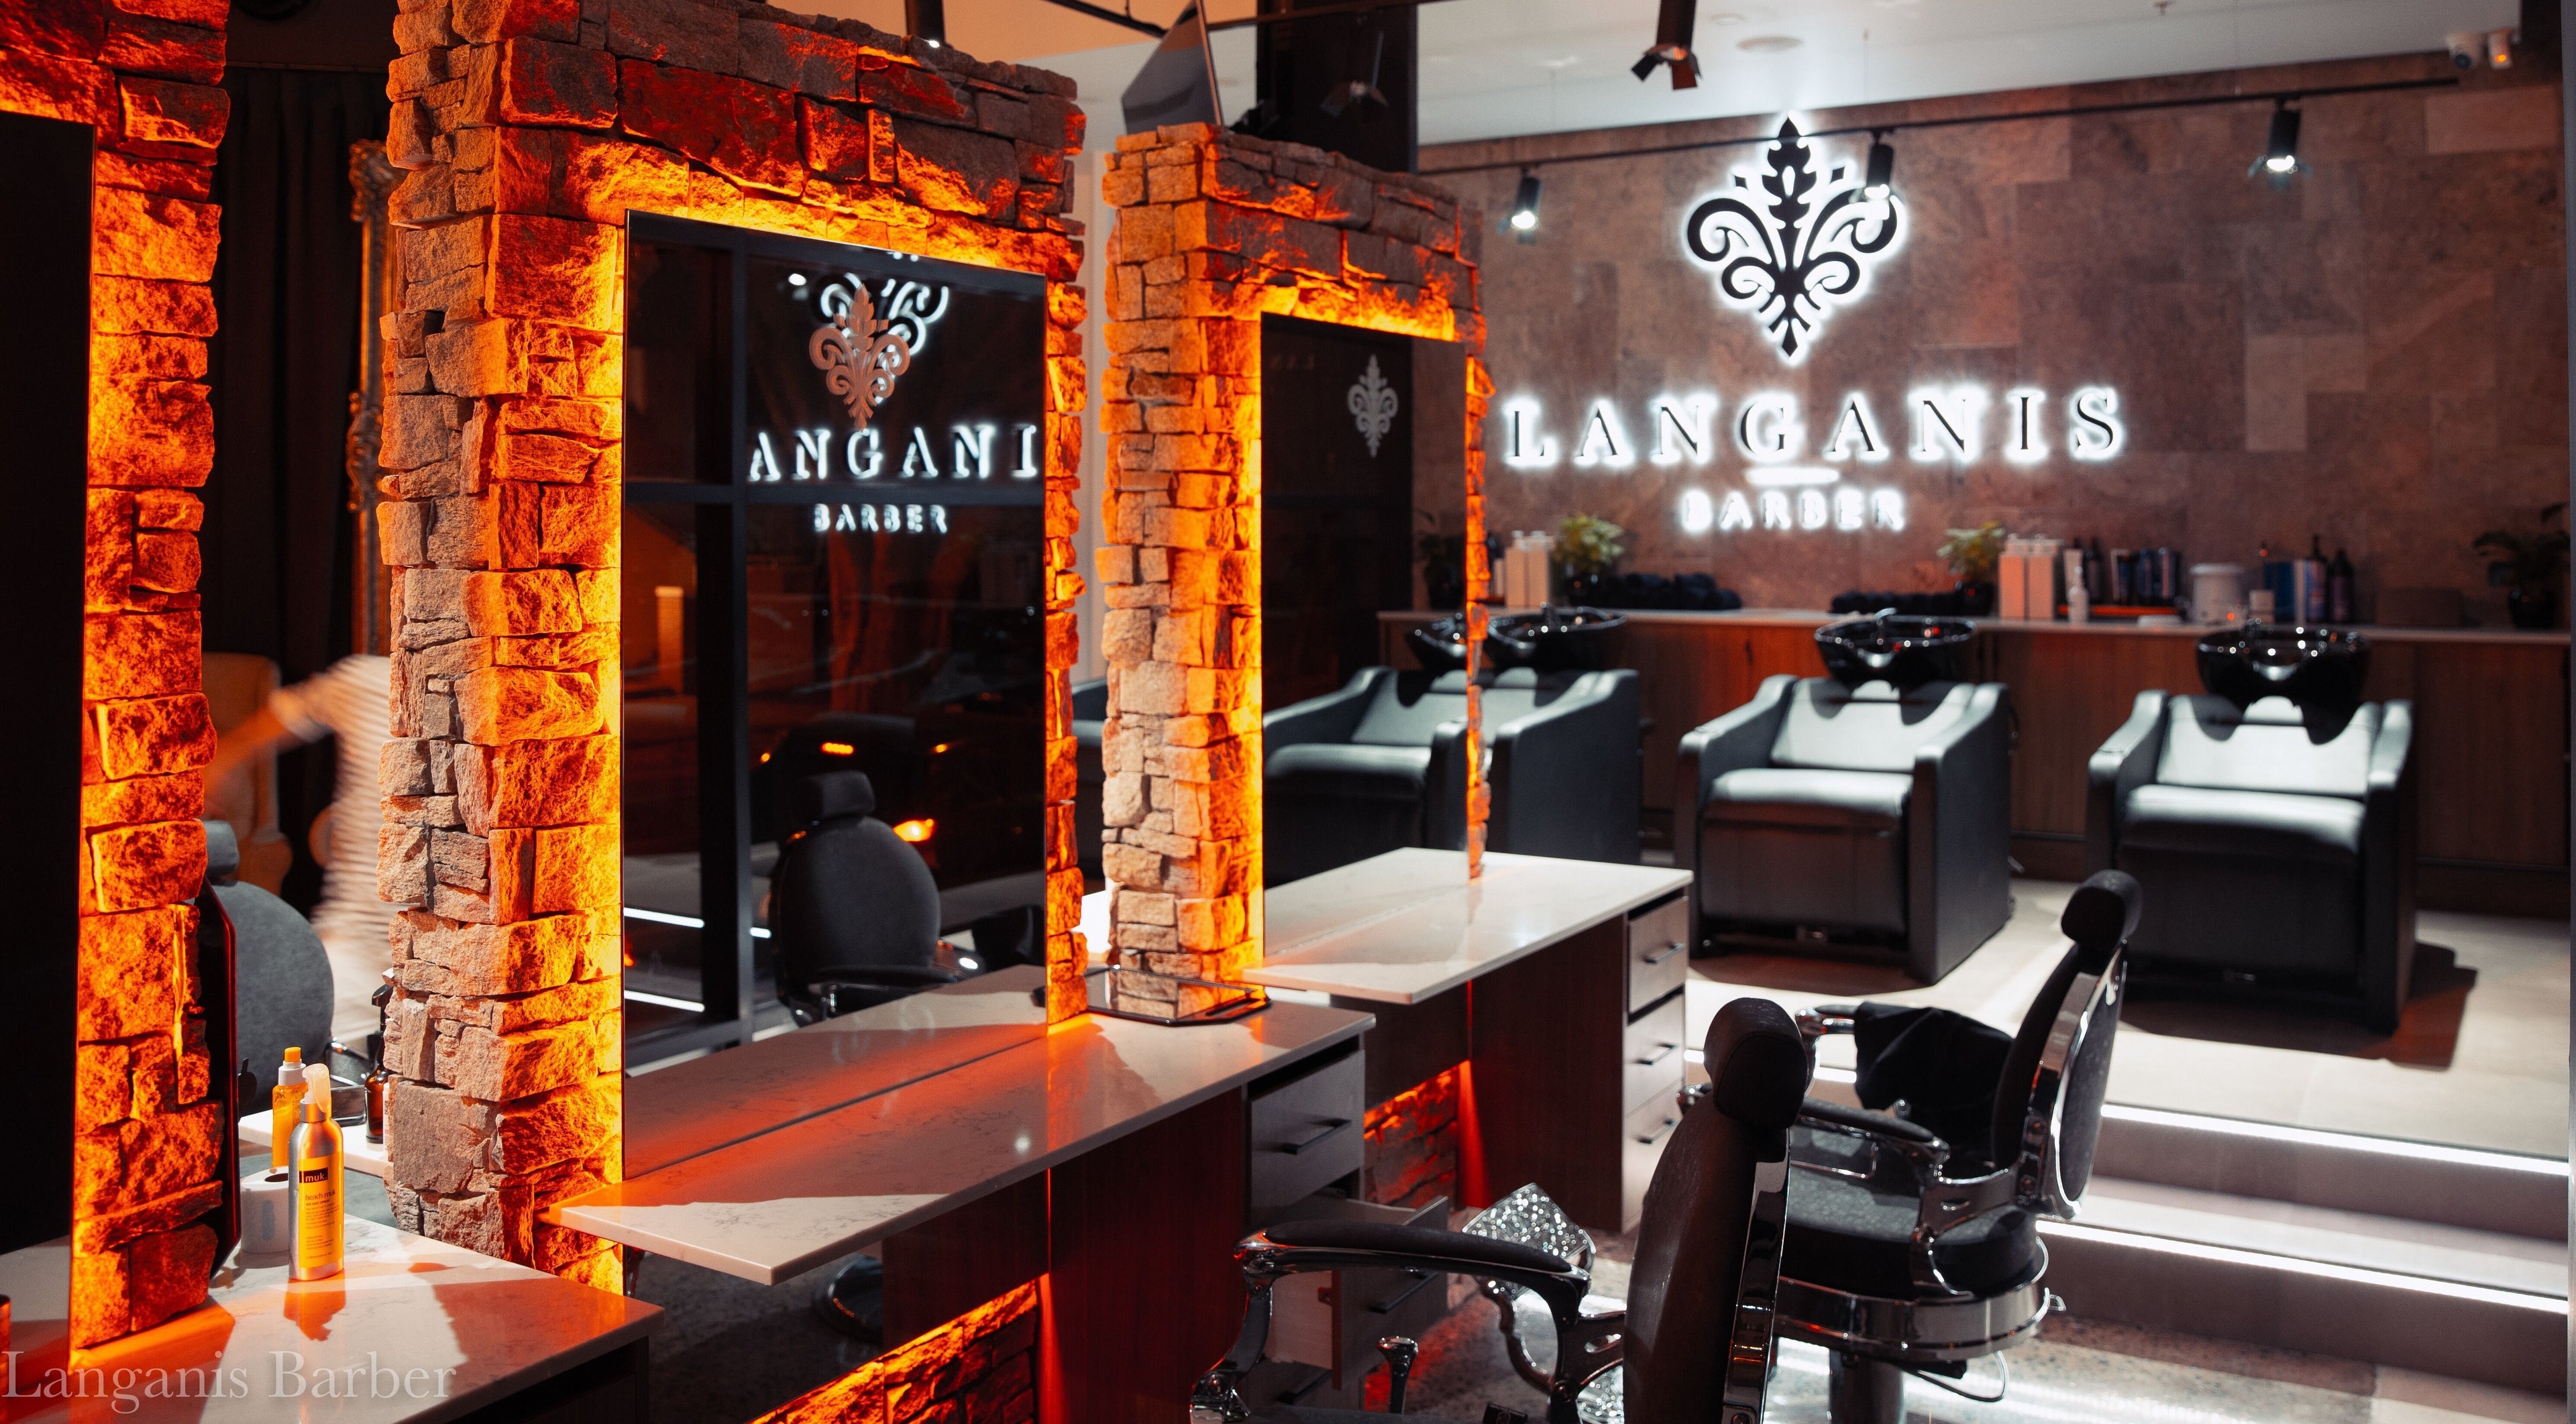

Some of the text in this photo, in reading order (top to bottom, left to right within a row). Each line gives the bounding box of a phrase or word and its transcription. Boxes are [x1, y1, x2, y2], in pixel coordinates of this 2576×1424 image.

[1505, 388, 2122, 465] LANGANIS
[814, 504, 947, 533] BARBER
[1680, 490, 1907, 531] BARBER
[305, 1192, 323, 1201] beach
